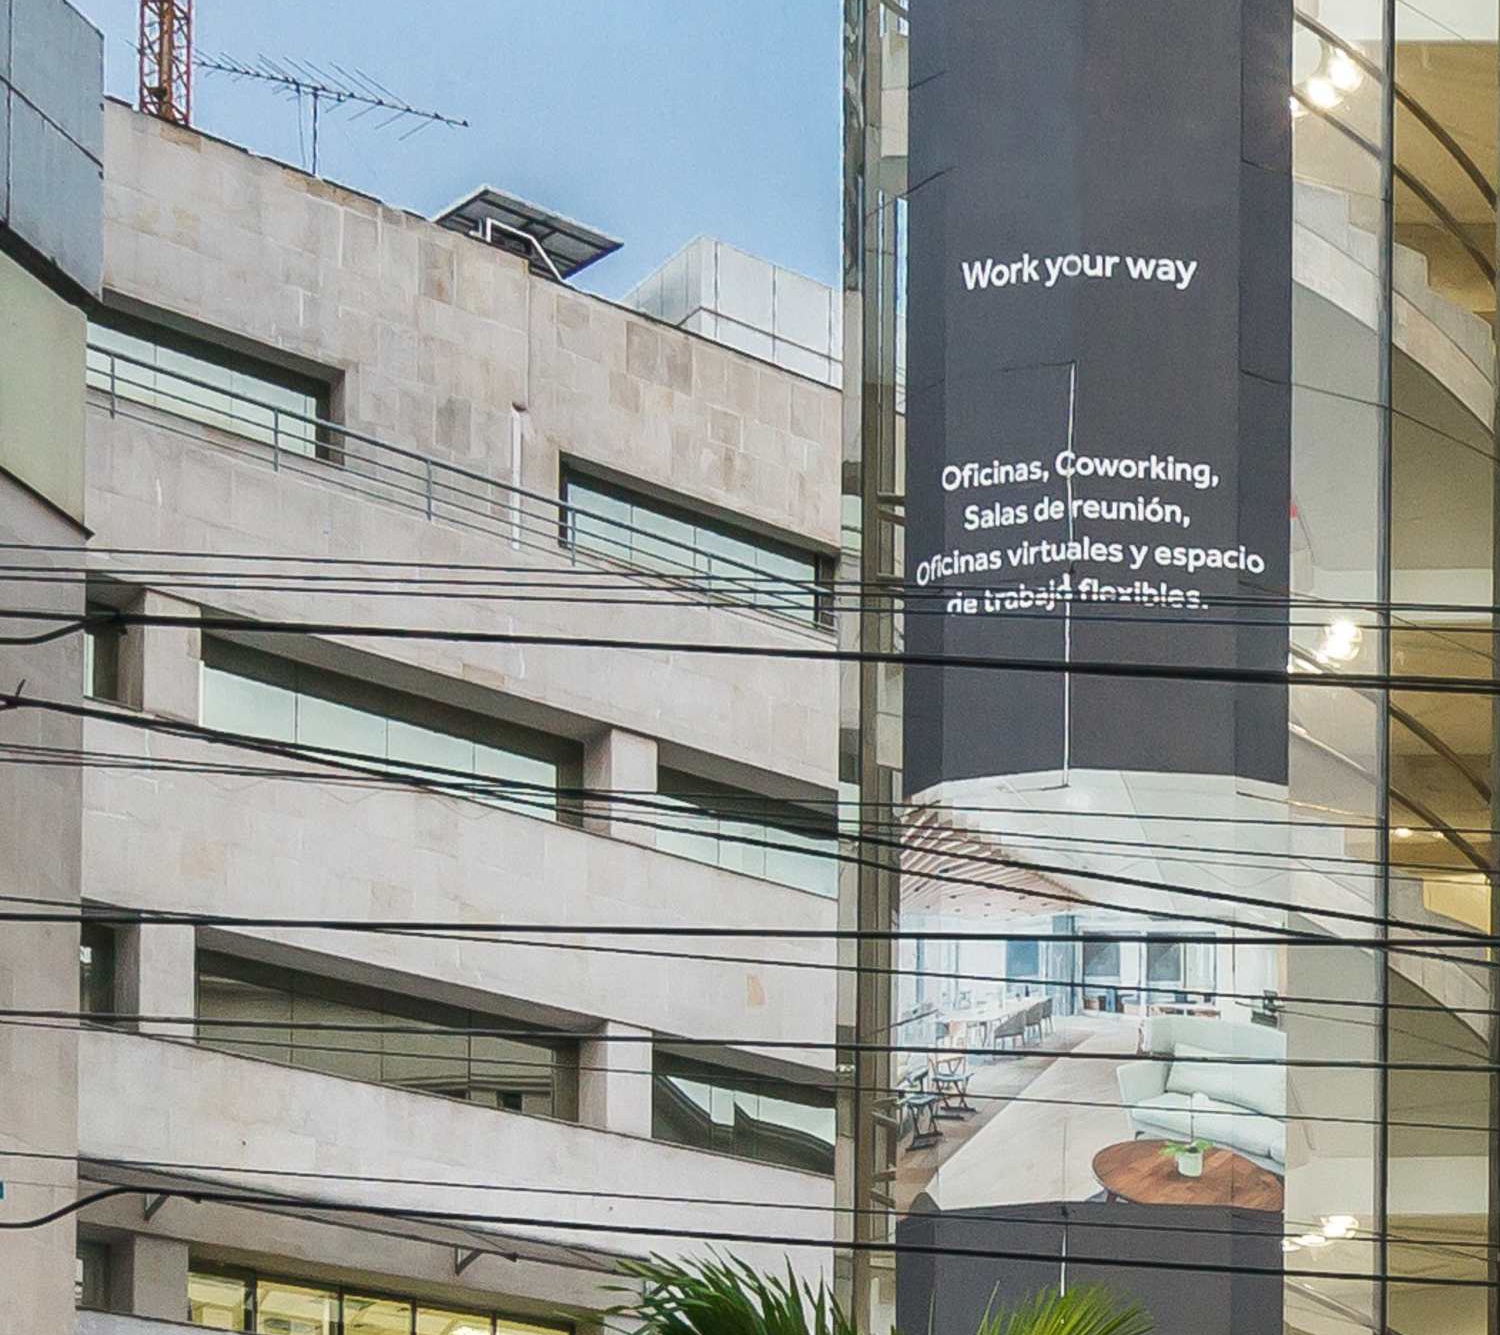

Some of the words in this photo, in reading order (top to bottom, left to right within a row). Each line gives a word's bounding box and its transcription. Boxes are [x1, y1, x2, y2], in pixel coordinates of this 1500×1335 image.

[962, 253, 1040, 290] Work
[1045, 254, 1120, 287] your
[1125, 255, 1198, 290] way
[941, 460, 1049, 491] Oficinas,
[1055, 450, 1220, 489] Coworking,
[964, 502, 1028, 530] Salas
[1033, 497, 1065, 522] de
[1072, 496, 1191, 528] reunión,
[915, 548, 1002, 586] Oficinas
[1006, 536, 1123, 566] virtuales
[1129, 544, 1149, 569] y
[1154, 545, 1265, 573] espacio
